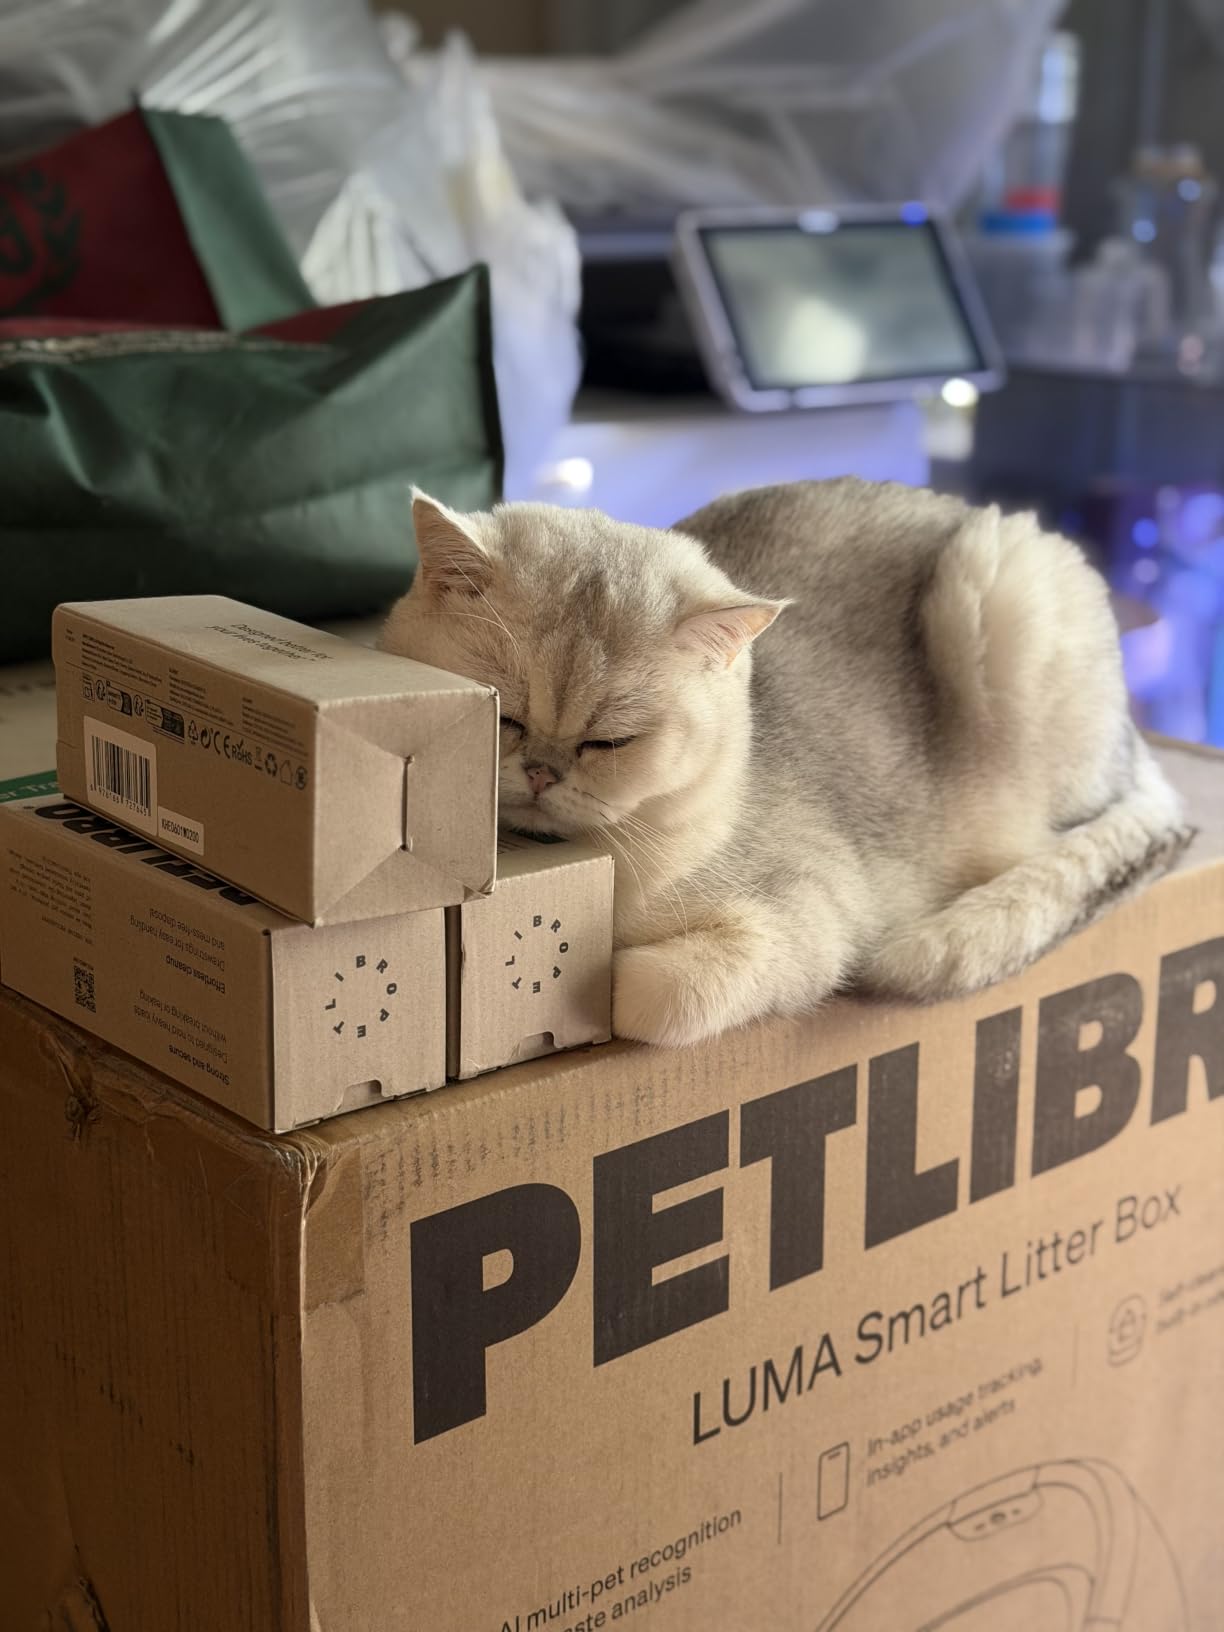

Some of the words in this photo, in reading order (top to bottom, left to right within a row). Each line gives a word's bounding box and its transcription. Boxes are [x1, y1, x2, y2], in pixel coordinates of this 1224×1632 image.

[130, 914, 158, 937] handling
[150, 908, 176, 929] disposal
[165, 955, 192, 977] cleanup
[193, 968, 226, 994] Effortless
[168, 1044, 191, 1063] secure
[191, 1056, 205, 1071] and
[206, 1062, 231, 1087] Strong
[410, 935, 1224, 1446] PETLIBR
[693, 1332, 842, 1445] LUMA
[854, 1267, 987, 1365] Smart
[1001, 1218, 1105, 1299] Litter
[1115, 1184, 1182, 1244] Box
[925, 1391, 975, 1427] usage
[501, 1615, 520, 1632] AI
[527, 1565, 625, 1632] multi-pet
[629, 1508, 742, 1579] recognition
[611, 1565, 692, 1621] analysis
